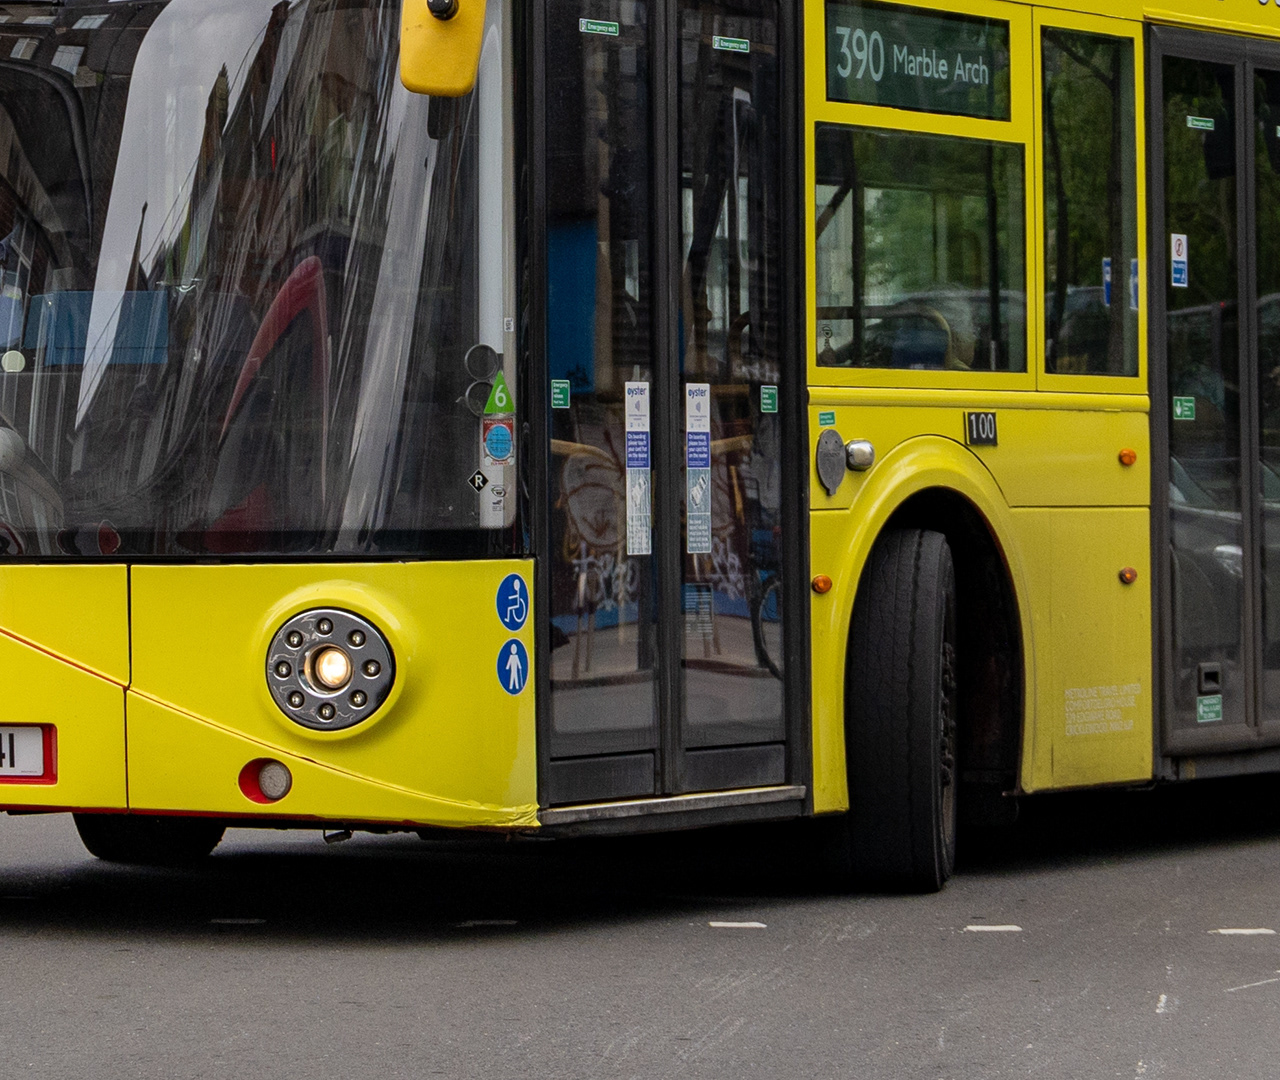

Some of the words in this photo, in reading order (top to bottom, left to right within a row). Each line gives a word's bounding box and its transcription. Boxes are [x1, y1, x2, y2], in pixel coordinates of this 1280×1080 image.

[835, 25, 885, 82] 390
[893, 44, 948, 80] Marble
[953, 52, 989, 85] Arch
[494, 384, 507, 408] 6
[627, 386, 647, 398] oyster
[688, 387, 707, 399] oyster
[970, 413, 995, 439] 100
[475, 475, 484, 487] R
